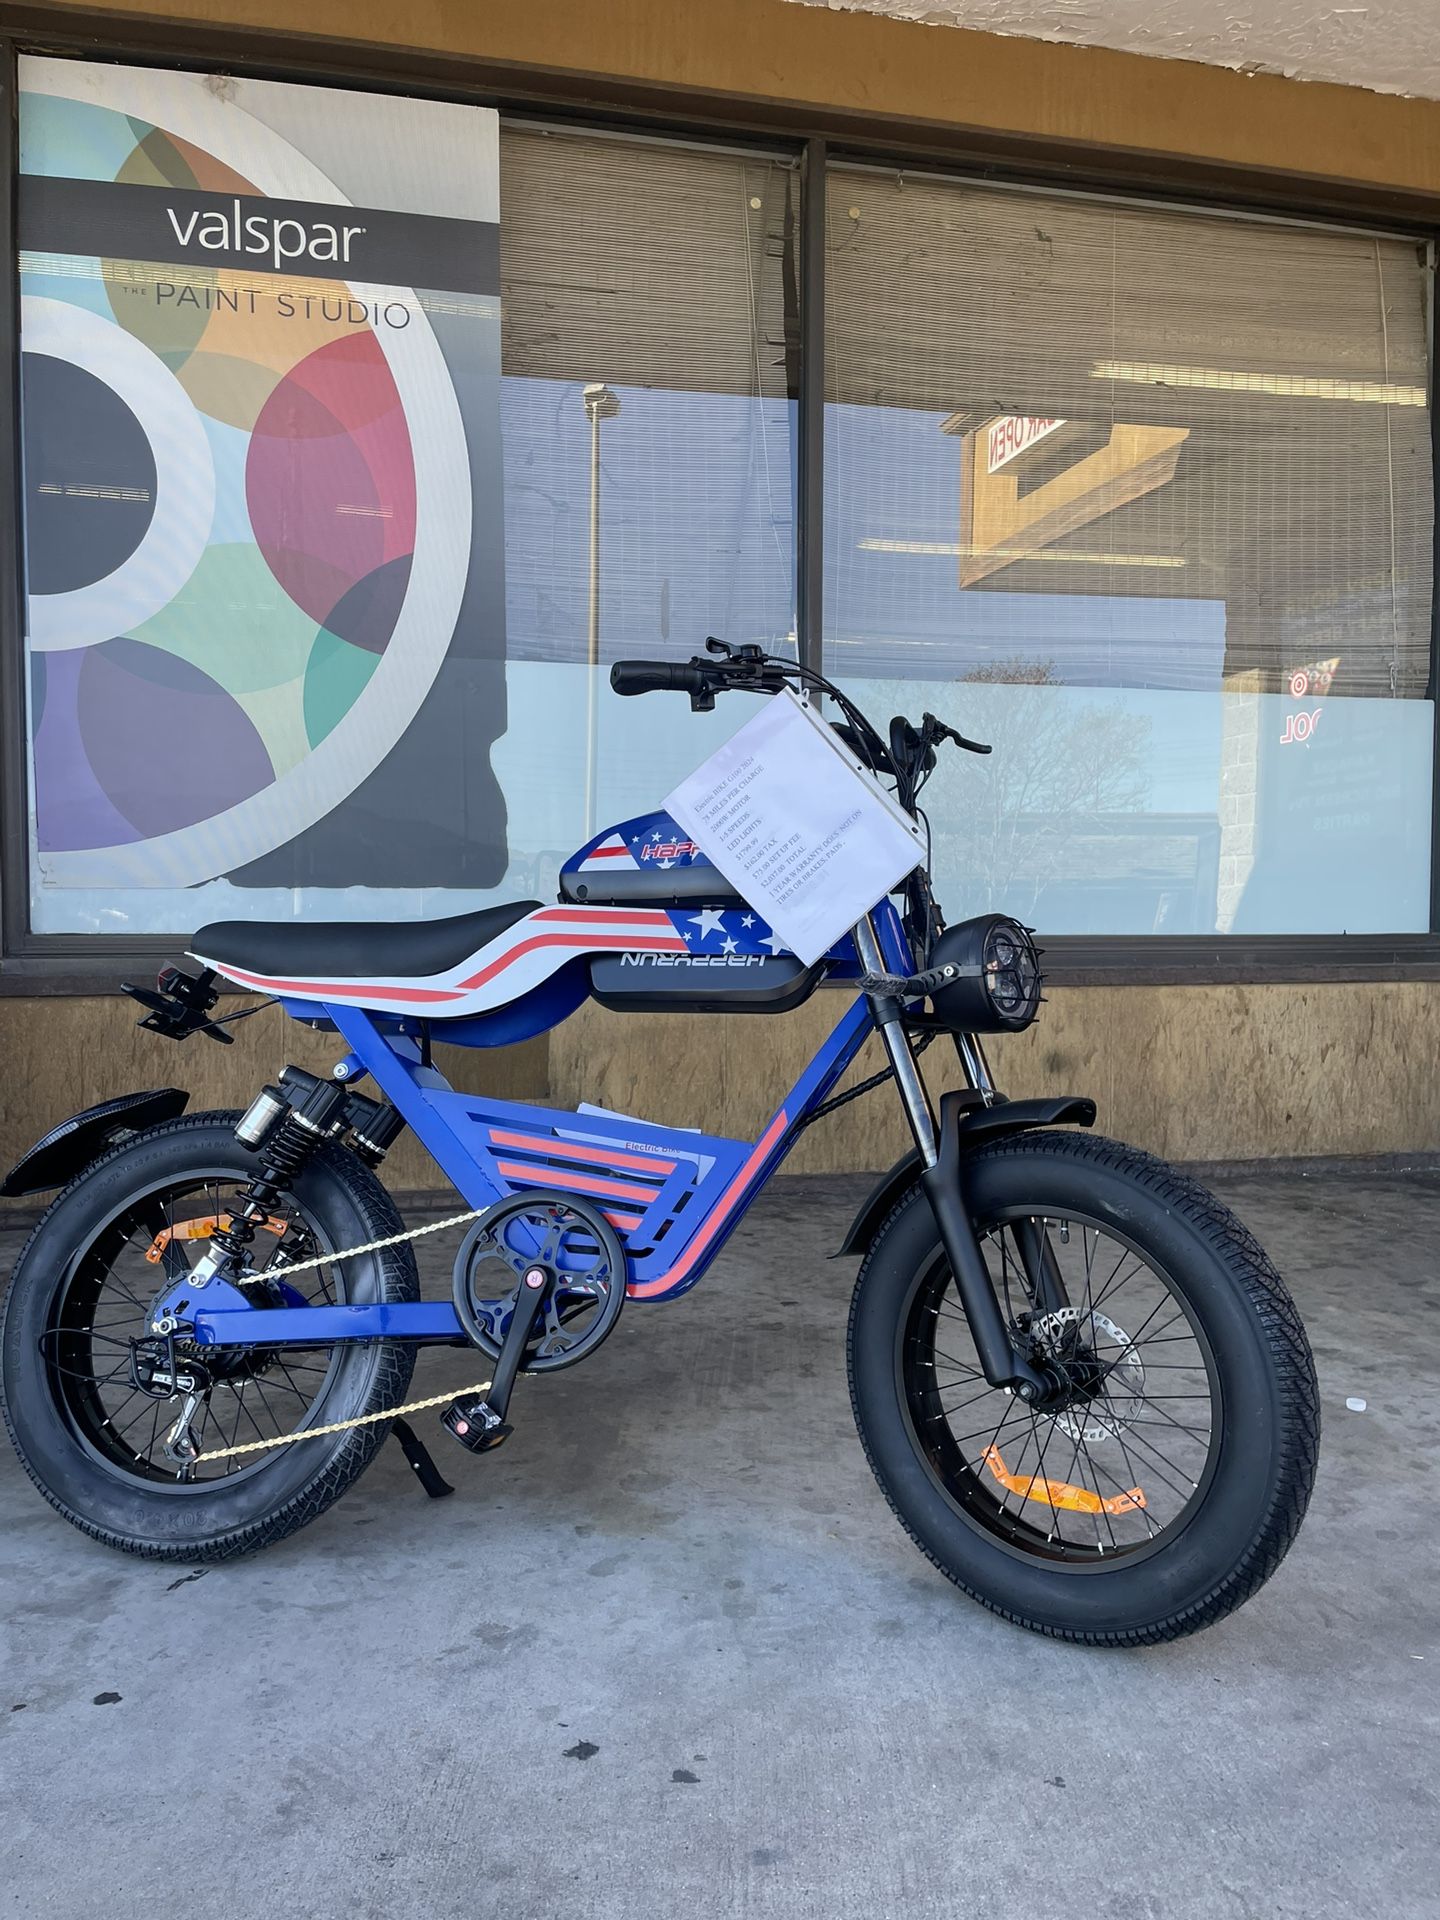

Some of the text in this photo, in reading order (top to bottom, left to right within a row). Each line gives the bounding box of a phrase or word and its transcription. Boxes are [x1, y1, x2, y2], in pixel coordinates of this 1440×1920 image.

[167, 199, 362, 269] valspar
[123, 282, 410, 329] THE PAINT STUDIO
[708, 797, 728, 817] MILES
[726, 787, 740, 800] PER
[737, 764, 764, 789] CHARGE
[711, 780, 728, 796] BIKE
[727, 793, 751, 816] MOTOR
[726, 811, 750, 834] SPEEDS
[726, 817, 762, 851] LED LIGHTS
[762, 837, 778, 851] TAX
[768, 850, 781, 864] SET
[778, 842, 789, 853] UP
[787, 832, 801, 846] FEE
[768, 808, 862, 898] 1 YEAR WARRANTY DOES NOT ON
[784, 845, 807, 864] TOTAL
[775, 887, 794, 905] TIRES
[792, 878, 803, 889] OR
[625, 1141, 660, 1152] Electric
